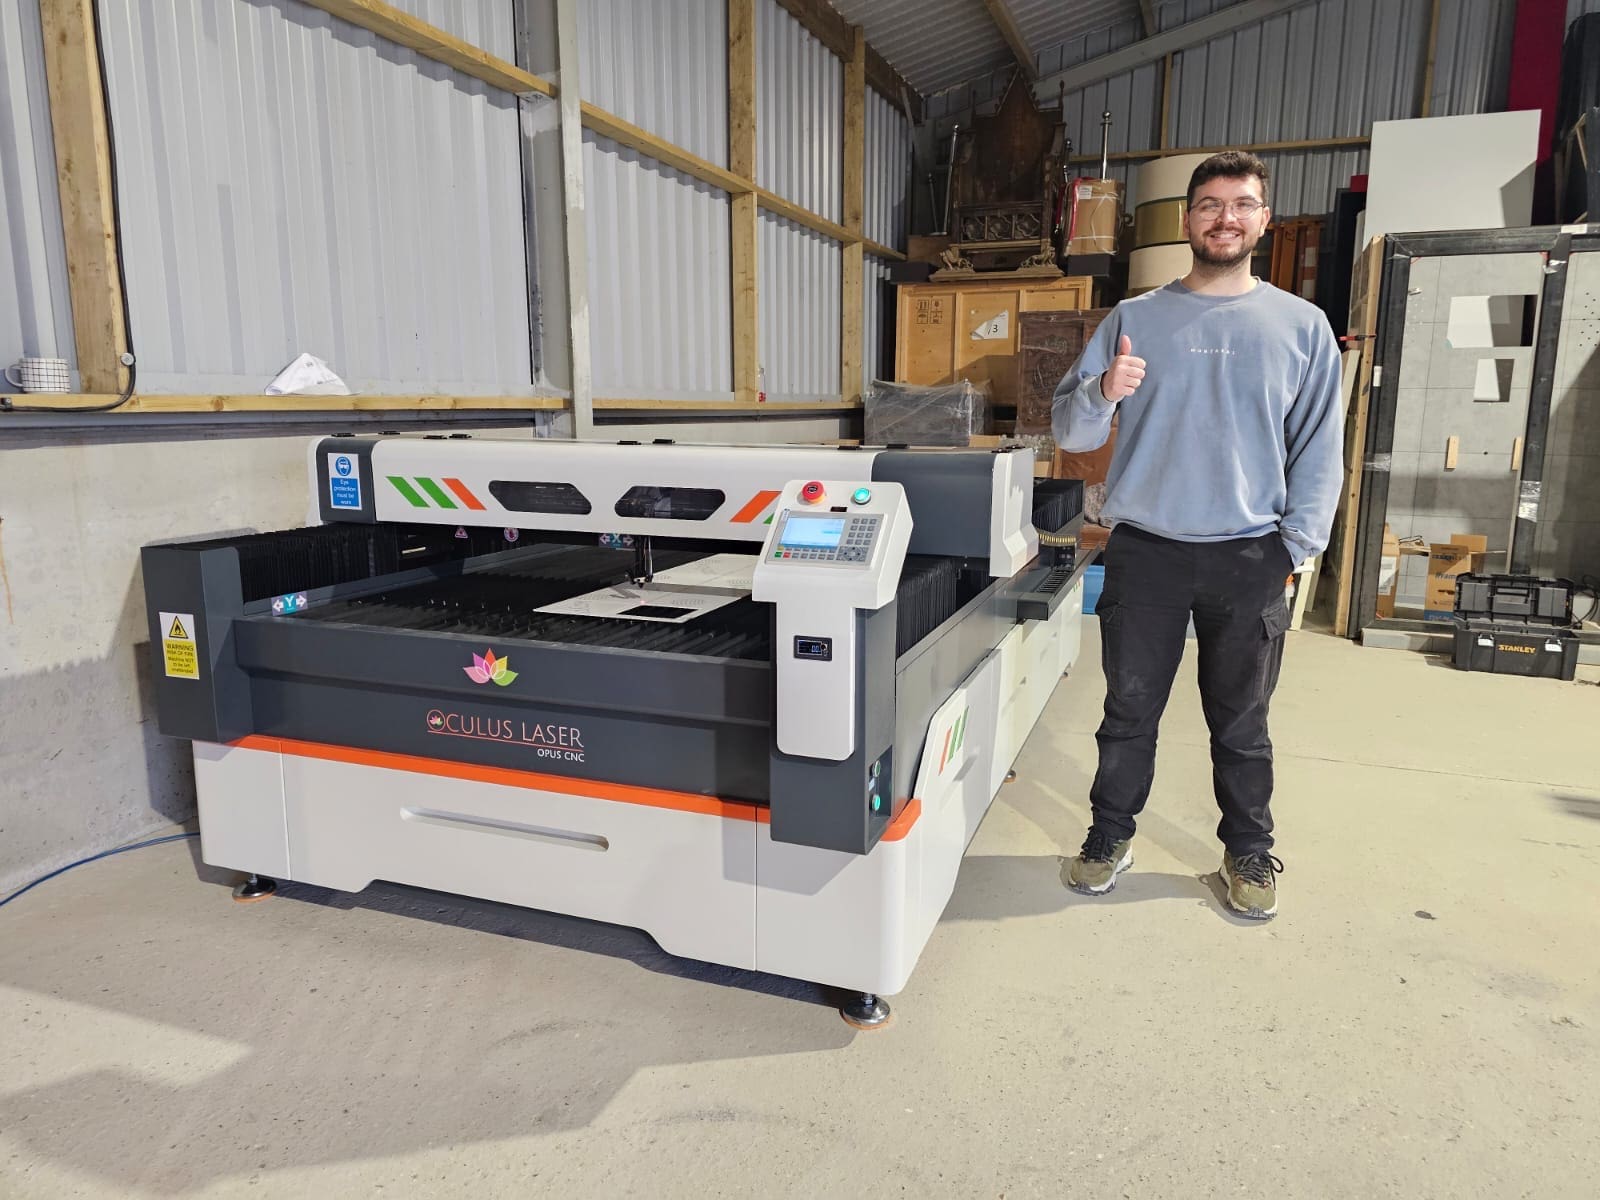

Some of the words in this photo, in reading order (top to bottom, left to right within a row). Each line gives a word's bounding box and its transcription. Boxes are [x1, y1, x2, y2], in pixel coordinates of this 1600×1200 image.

[285, 595, 294, 607] Y
[166, 643, 193, 651] WARNING
[1498, 644, 1536, 654] STANLEY
[426, 709, 513, 739] OCULUS
[522, 721, 584, 748] LASER
[537, 748, 562, 760] OPUS
[564, 751, 585, 763] CNC
